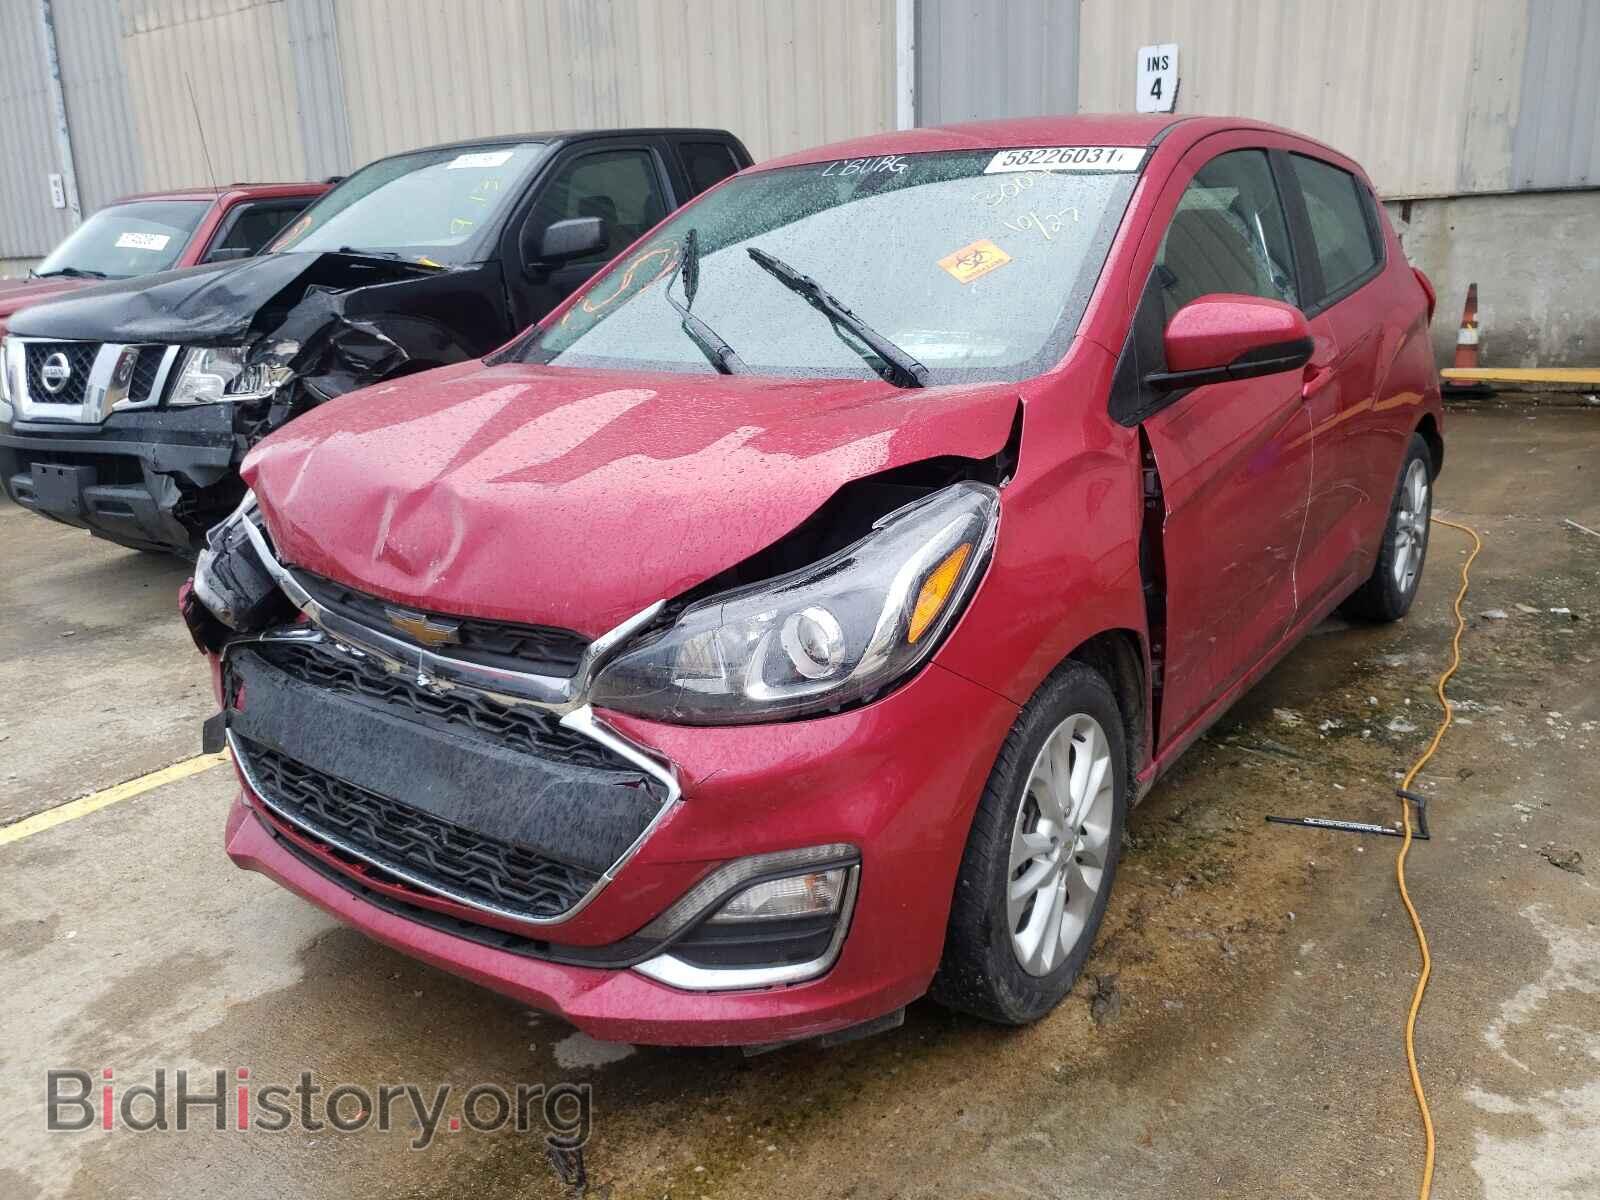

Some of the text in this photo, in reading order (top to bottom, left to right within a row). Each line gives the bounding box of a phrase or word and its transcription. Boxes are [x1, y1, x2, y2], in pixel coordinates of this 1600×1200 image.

[1146, 55, 1169, 72] INS
[1150, 77, 1163, 100] 4
[1003, 206, 1079, 240] 10/27
